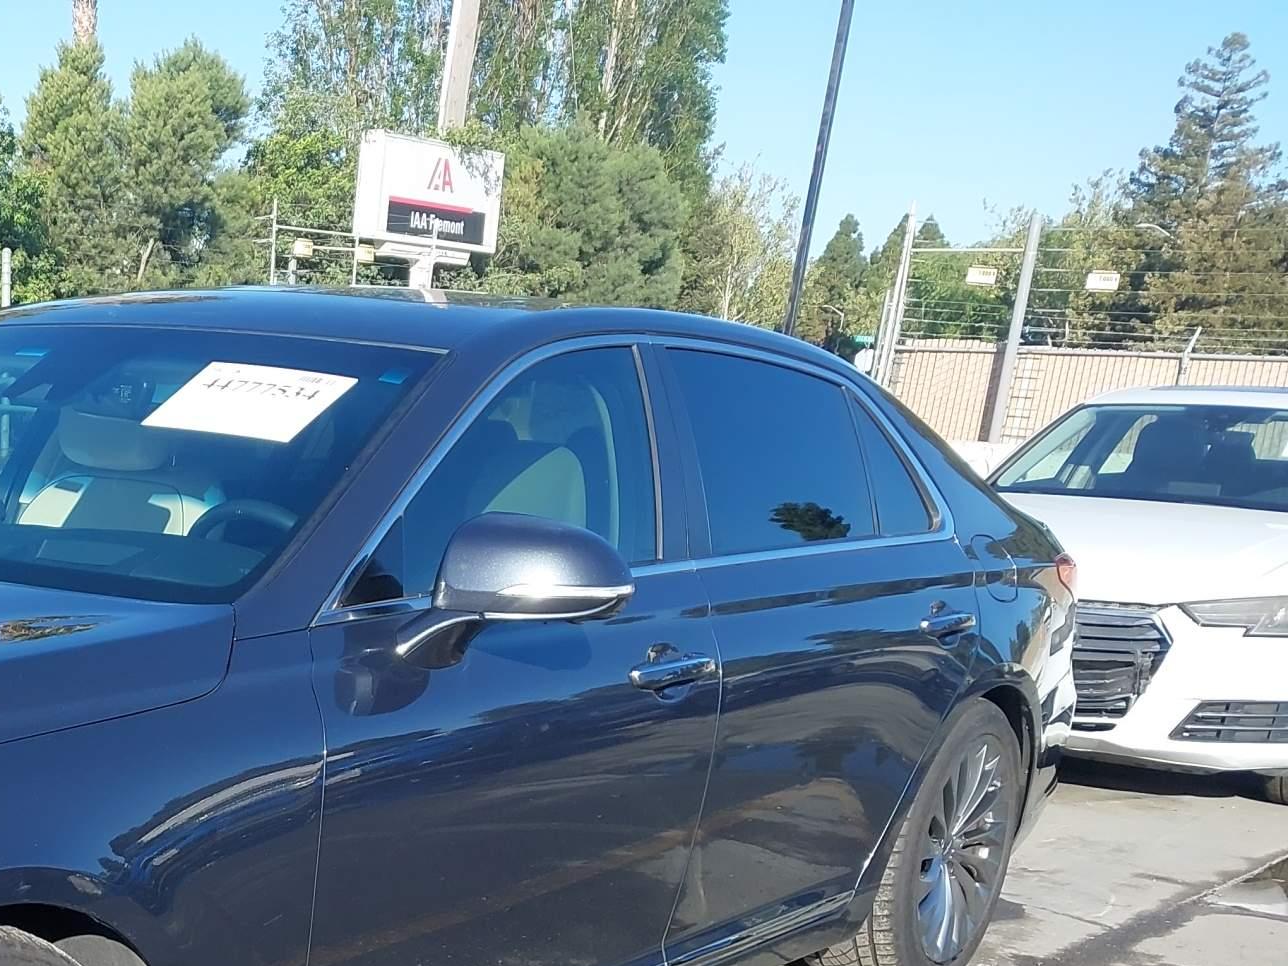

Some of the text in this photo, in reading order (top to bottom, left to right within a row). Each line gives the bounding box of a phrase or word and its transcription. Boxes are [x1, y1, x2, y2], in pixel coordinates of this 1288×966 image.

[410, 211, 464, 235] IAA Femont
[202, 377, 320, 401] 44777534
